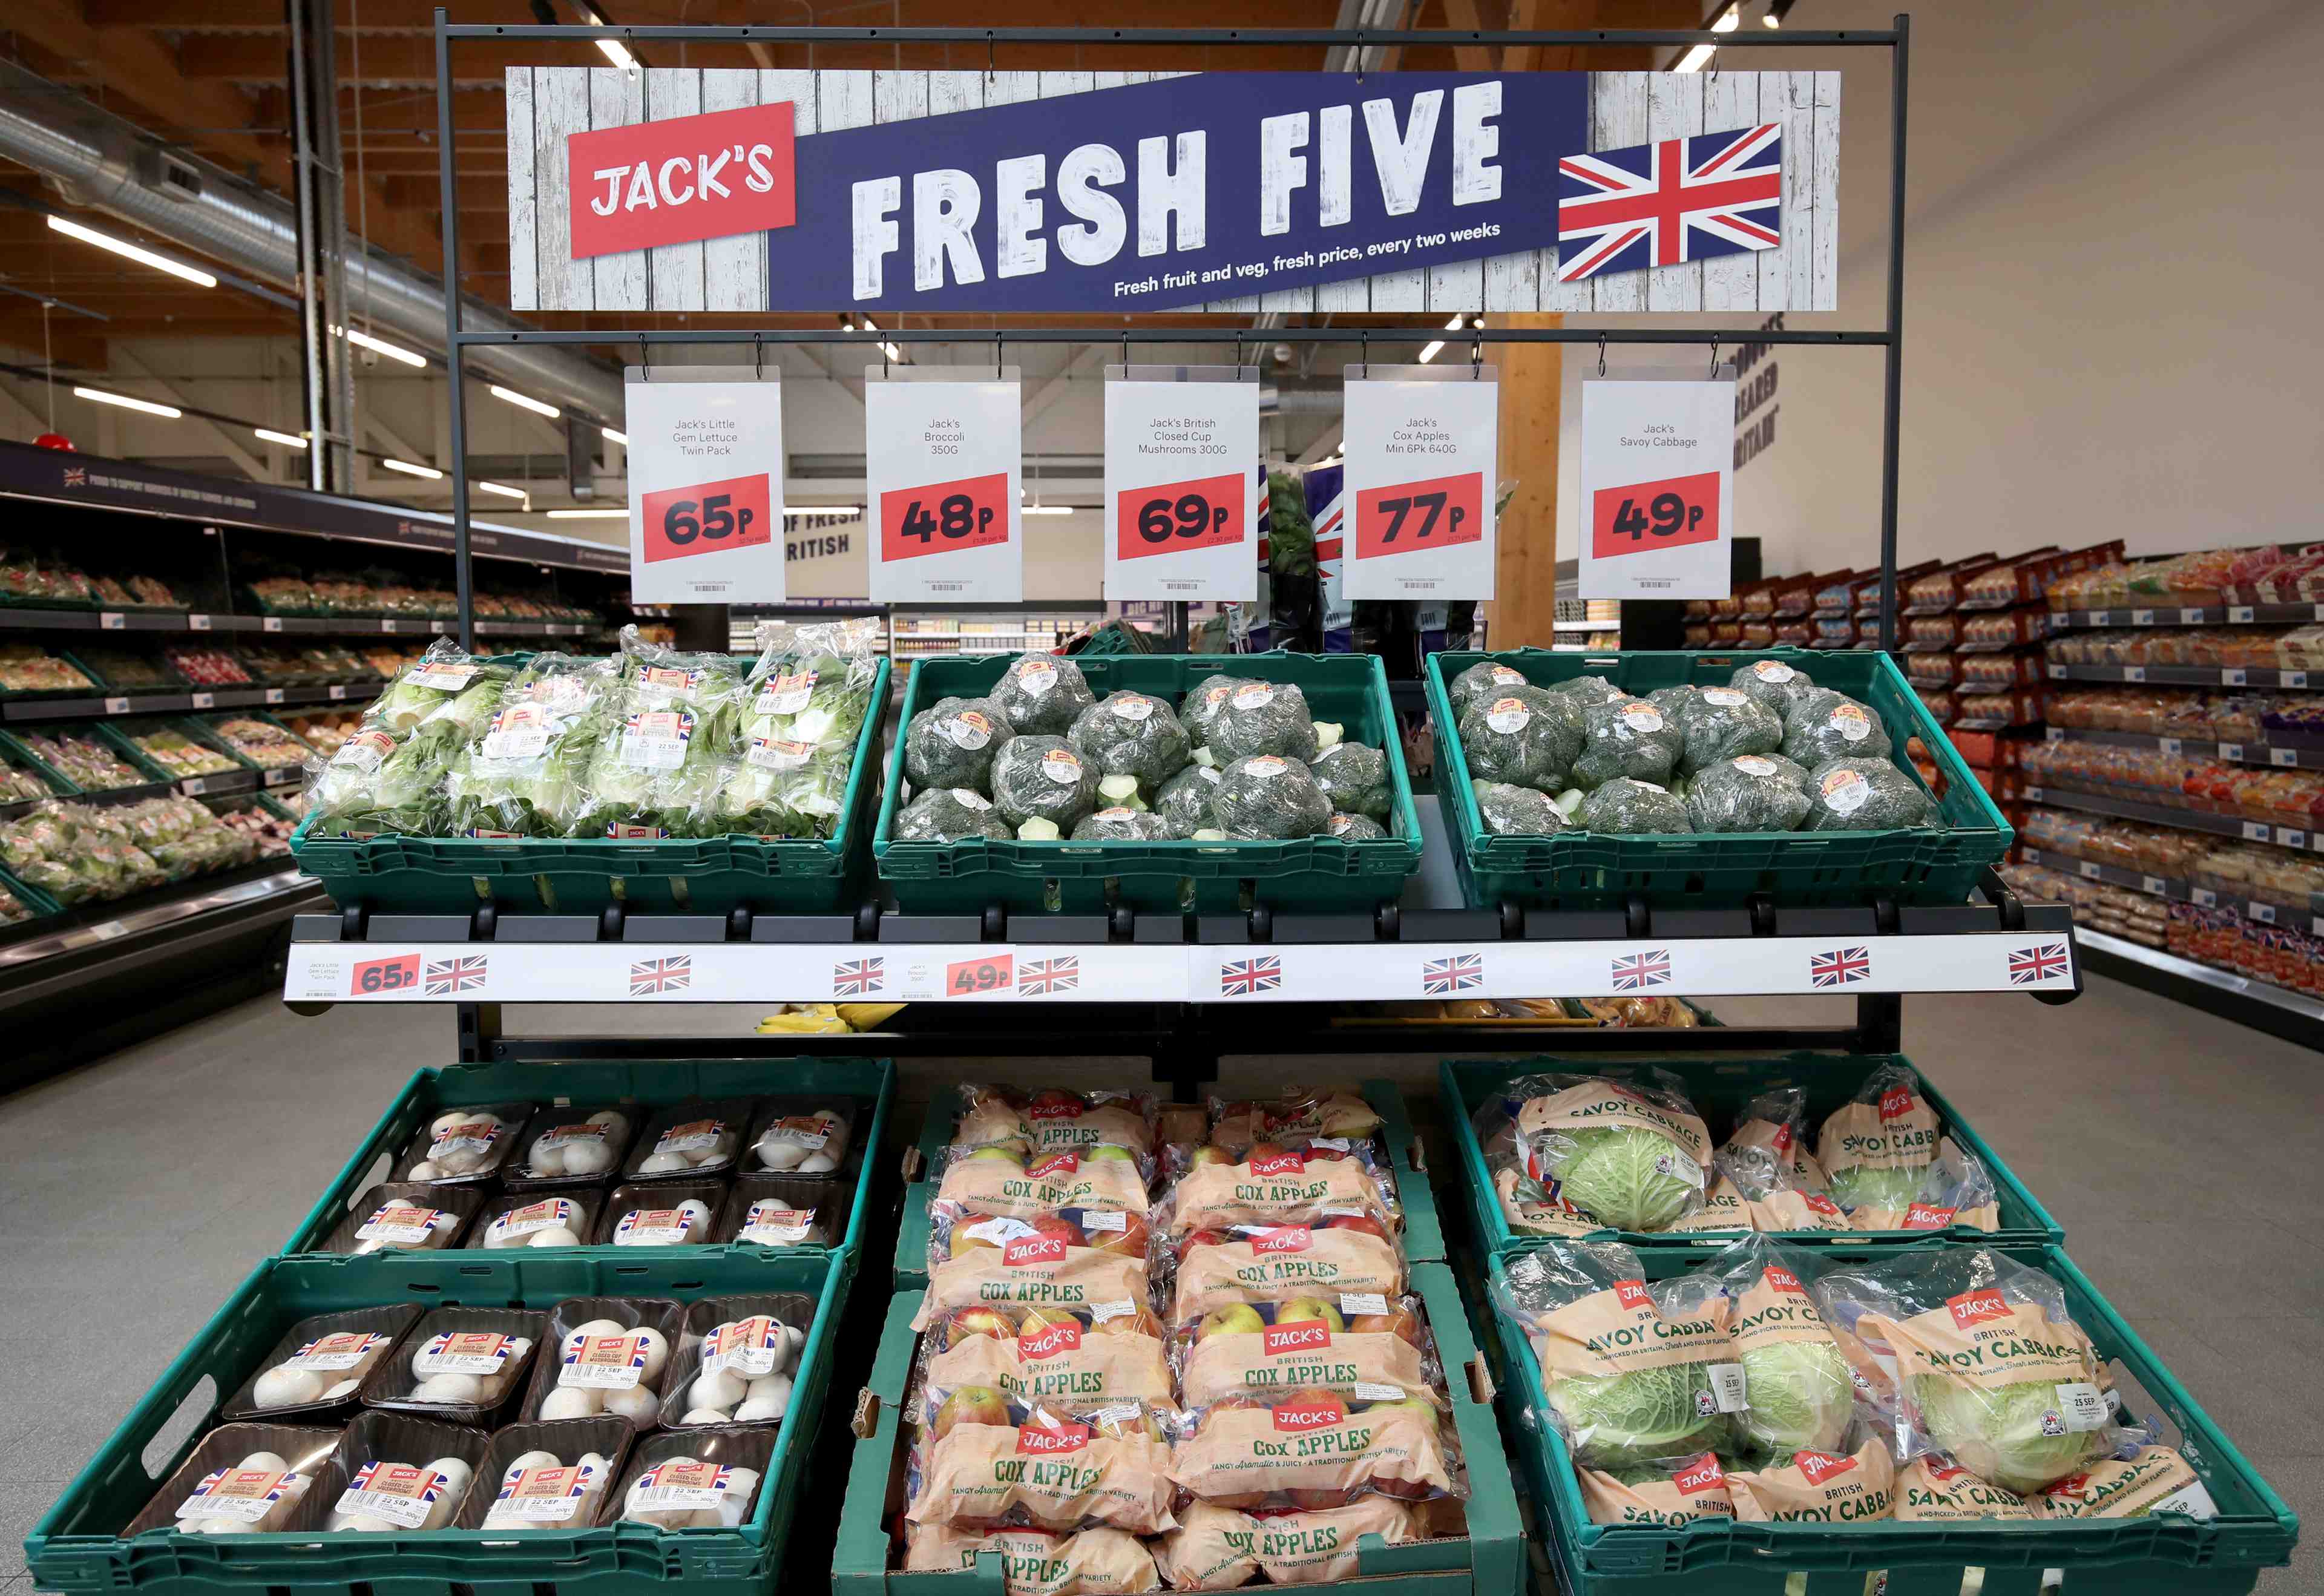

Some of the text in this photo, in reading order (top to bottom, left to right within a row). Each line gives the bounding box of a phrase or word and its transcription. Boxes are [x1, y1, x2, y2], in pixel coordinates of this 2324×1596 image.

[590, 144, 774, 215] JACK'S
[845, 80, 1502, 300] FRESH FIVE
[1114, 222, 1500, 297] Fresh fruit and veg, fresh price, every two weeks
[675, 419, 735, 429] Jack's Little
[929, 419, 960, 429] Jack's
[1150, 418, 1215, 428] Jack's British
[1406, 418, 1437, 427] Jack's
[1644, 424, 1675, 434] Jack's
[673, 433, 737, 442] Gem Lettuce
[925, 432, 964, 442] Broccoli
[1154, 431, 1211, 442] Closed Cup
[1393, 430, 1449, 442] Cox Apples
[1621, 437, 1697, 448] Savoy Cabbage
[680, 446, 731, 455] Twin Pack
[931, 445, 957, 455] 350G
[1138, 444, 1227, 454] Mushrooms 300G
[1386, 444, 1457, 454] Min 6Pk 640G
[787, 534, 849, 560] RITISH
[1883, 1094, 1909, 1111] ACK'S
[1570, 1101, 1701, 1148] SAVOY CABBAGE
[1043, 1129, 1099, 1144] APPLES
[1843, 1130, 1936, 1151] SAVOY CABB
[1028, 1155, 1074, 1177] JACK'S
[1254, 1156, 1299, 1172] JACK'S
[1003, 1180, 1092, 1203] COX APPLES
[1236, 1181, 1328, 1201] COX APPLES
[1909, 1209, 1952, 1225] JACK'S
[1258, 1227, 1307, 1250] JACK'S
[1009, 1240, 1061, 1260] JACK'S
[1012, 1271, 1054, 1280] BRITISH
[1238, 1263, 1339, 1282] COX APPLES
[980, 1283, 1084, 1301] COX APPLES
[1955, 1298, 2002, 1319] JACK'S
[1728, 1306, 1793, 1338] SAVOY
[1023, 1330, 1075, 1352] JACK'S
[1269, 1328, 1324, 1347] JACK'S
[1586, 1324, 1644, 1352] AVOY
[1974, 1329, 2017, 1342] BRITISH
[1028, 1361, 1070, 1373] BRITISH
[1277, 1356, 1323, 1364] BRITISH
[1000, 1372, 1103, 1395] COX APPLES
[1246, 1364, 1357, 1387] COX APPLES
[1725, 1379, 1732, 1388] 25
[2075, 1397, 2095, 1407] 25 SEP
[1279, 1411, 1337, 1424] JACK'S
[1023, 1432, 1082, 1450] JACK'S
[1253, 1428, 1371, 1457] COX APPLES
[1212, 1463, 1234, 1471] TANGY
[1235, 1459, 1274, 1470] Aromatic
[1315, 1456, 1356, 1467] TRADITIONAL
[995, 1460, 1103, 1489] COX APPLES
[1682, 1462, 1723, 1489] JACK
[2114, 1462, 2175, 1503] AND FULL FLAVOUR
[377, 1485, 412, 1494] MUSHROOMS
[1110, 1489, 1136, 1499] VARIETY
[1825, 1482, 1863, 1499] BRITISH
[1695, 1499, 1731, 1512] BRITISH
[994, 1539, 1044, 1552] BRITISH
[1224, 1526, 1338, 1555] COX APPLES
[1279, 1551, 1353, 1568] TRADITIONAL BRITISH
[1014, 1585, 1058, 1594] TRADITIONAL
